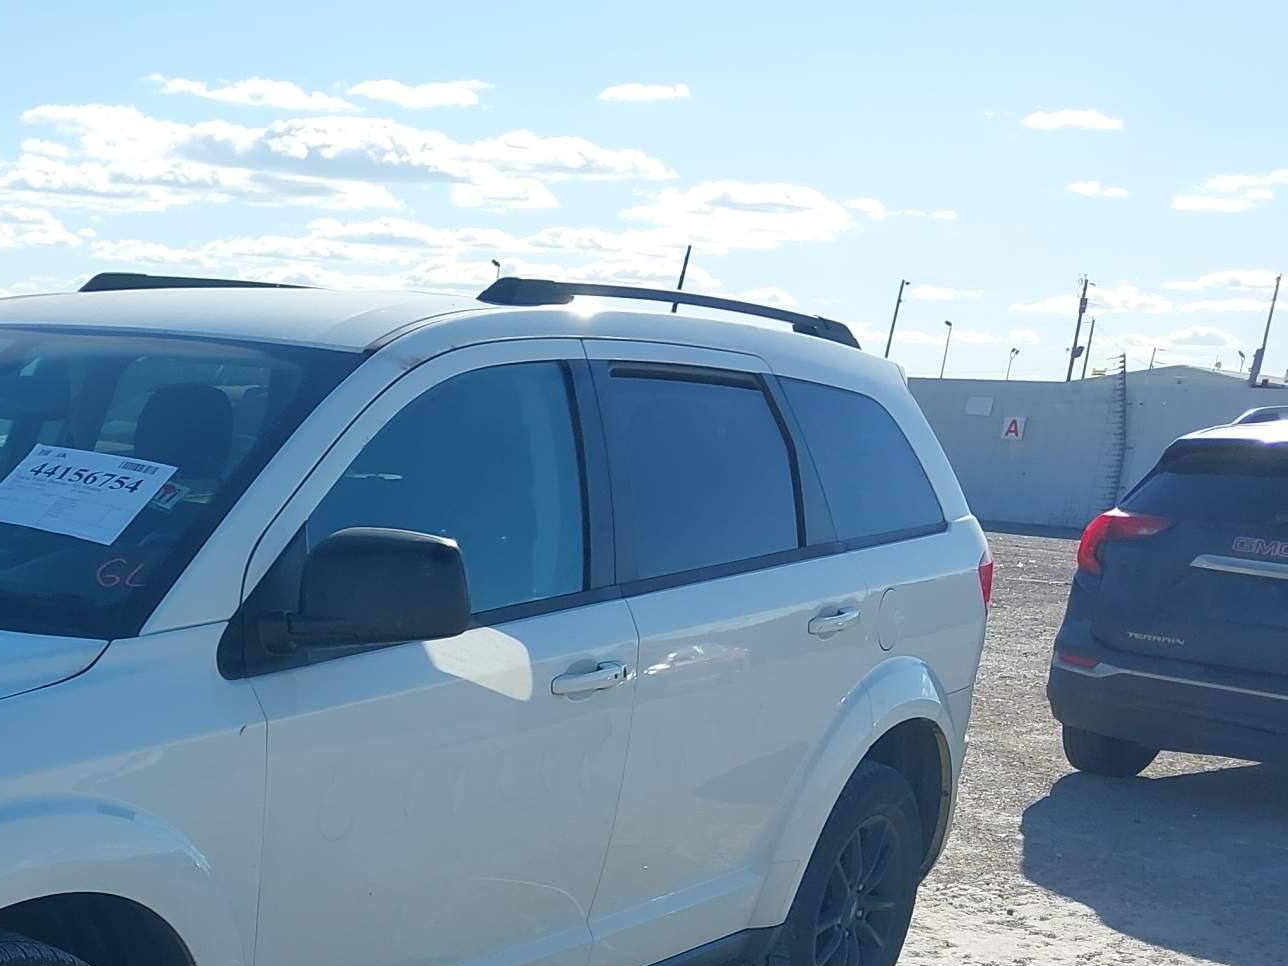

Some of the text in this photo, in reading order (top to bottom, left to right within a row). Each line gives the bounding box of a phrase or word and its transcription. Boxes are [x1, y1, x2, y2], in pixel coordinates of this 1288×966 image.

[1005, 419, 1018, 437] A
[30, 462, 144, 493] 44156754
[1127, 632, 1184, 645] TERRAIN
